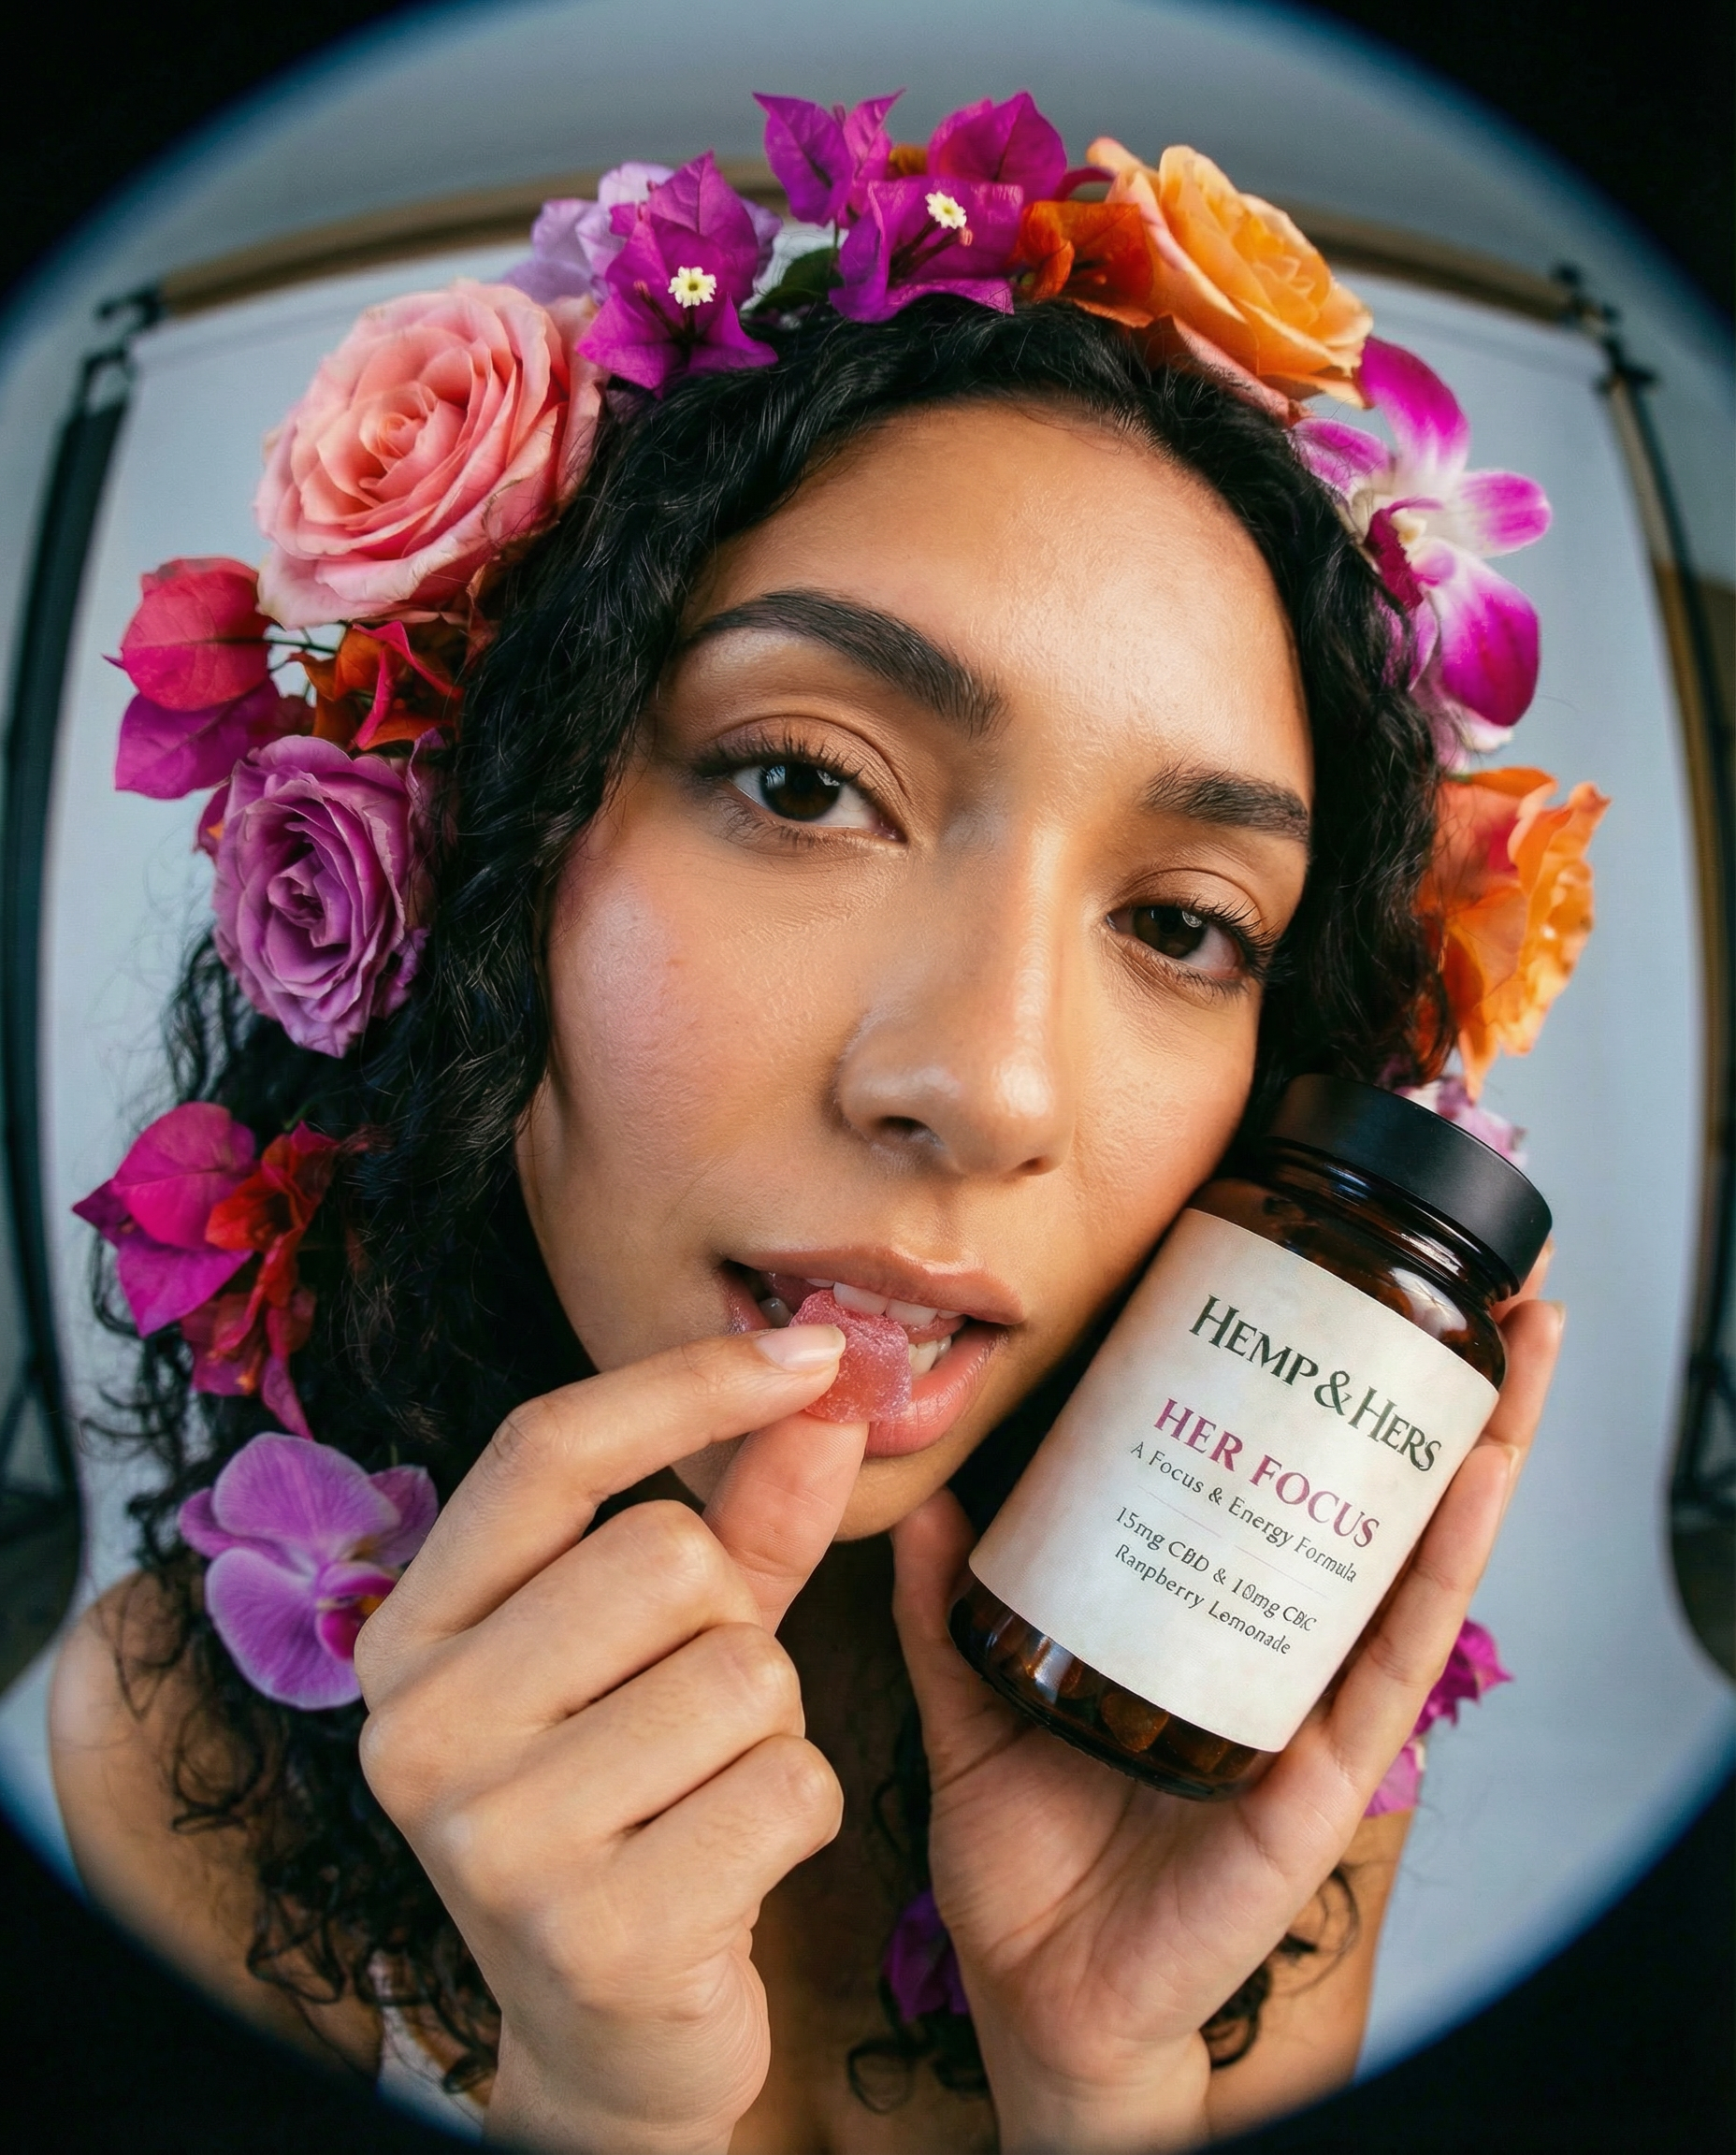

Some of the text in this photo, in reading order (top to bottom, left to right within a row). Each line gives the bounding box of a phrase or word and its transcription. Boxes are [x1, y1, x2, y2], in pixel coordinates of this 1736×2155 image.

[1130, 1441, 1356, 1583] A Focus & Energy Formula
[1153, 1398, 1380, 1547] HER FOCUS
[1116, 1506, 1165, 1551] 15mg
[1212, 1568, 1226, 1585] &
